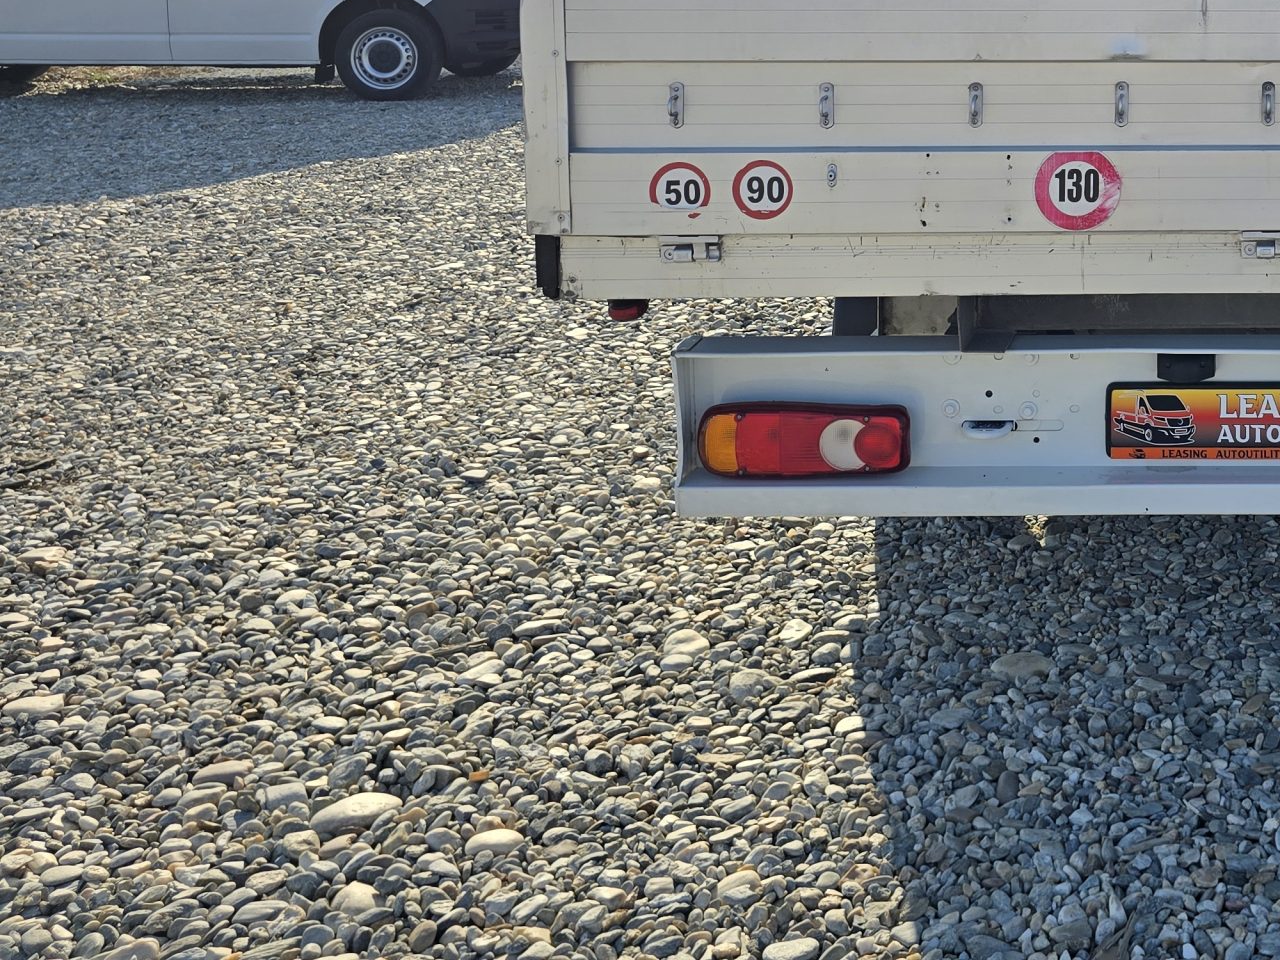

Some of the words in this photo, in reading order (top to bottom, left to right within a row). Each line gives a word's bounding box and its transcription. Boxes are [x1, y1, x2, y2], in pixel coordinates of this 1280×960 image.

[664, 179, 701, 206] 50
[746, 176, 785, 204] 90
[1054, 168, 1100, 203] 130
[1162, 449, 1208, 459] LEASING
